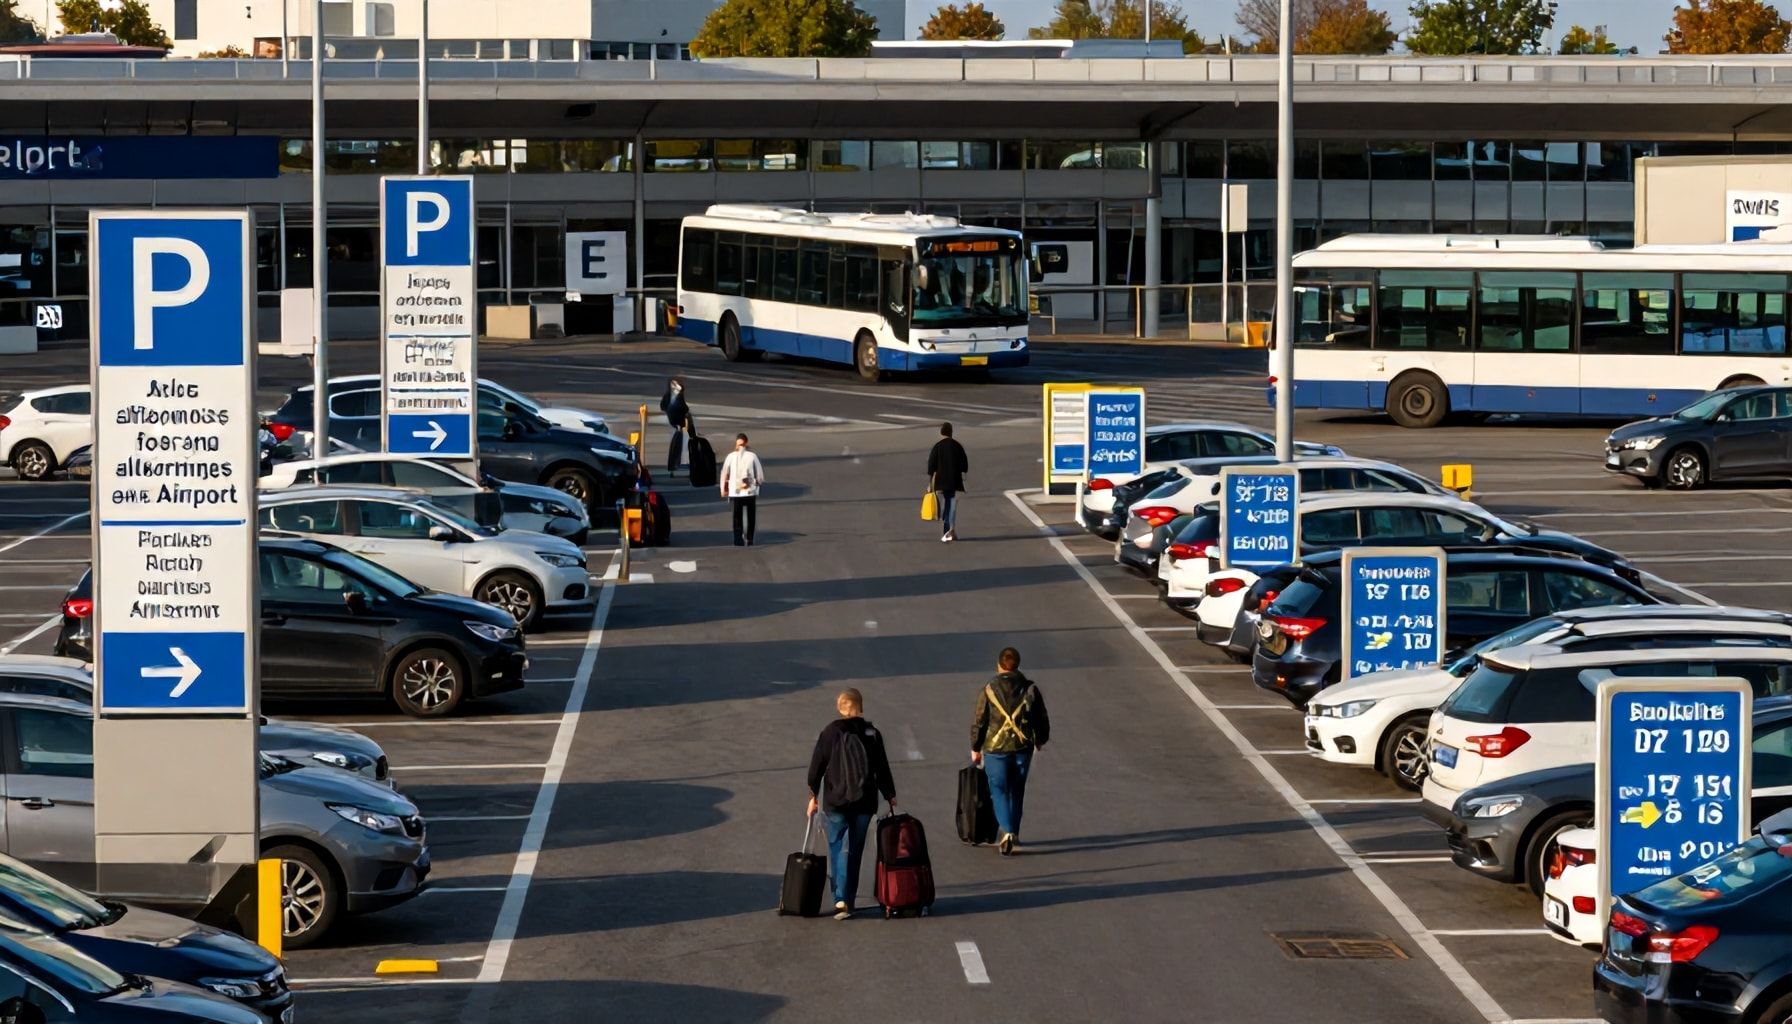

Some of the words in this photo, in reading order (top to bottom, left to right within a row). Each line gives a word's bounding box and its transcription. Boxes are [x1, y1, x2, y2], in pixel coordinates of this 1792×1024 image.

[407, 191, 451, 257] P
[582, 240, 607, 279] E
[133, 237, 210, 350] P
